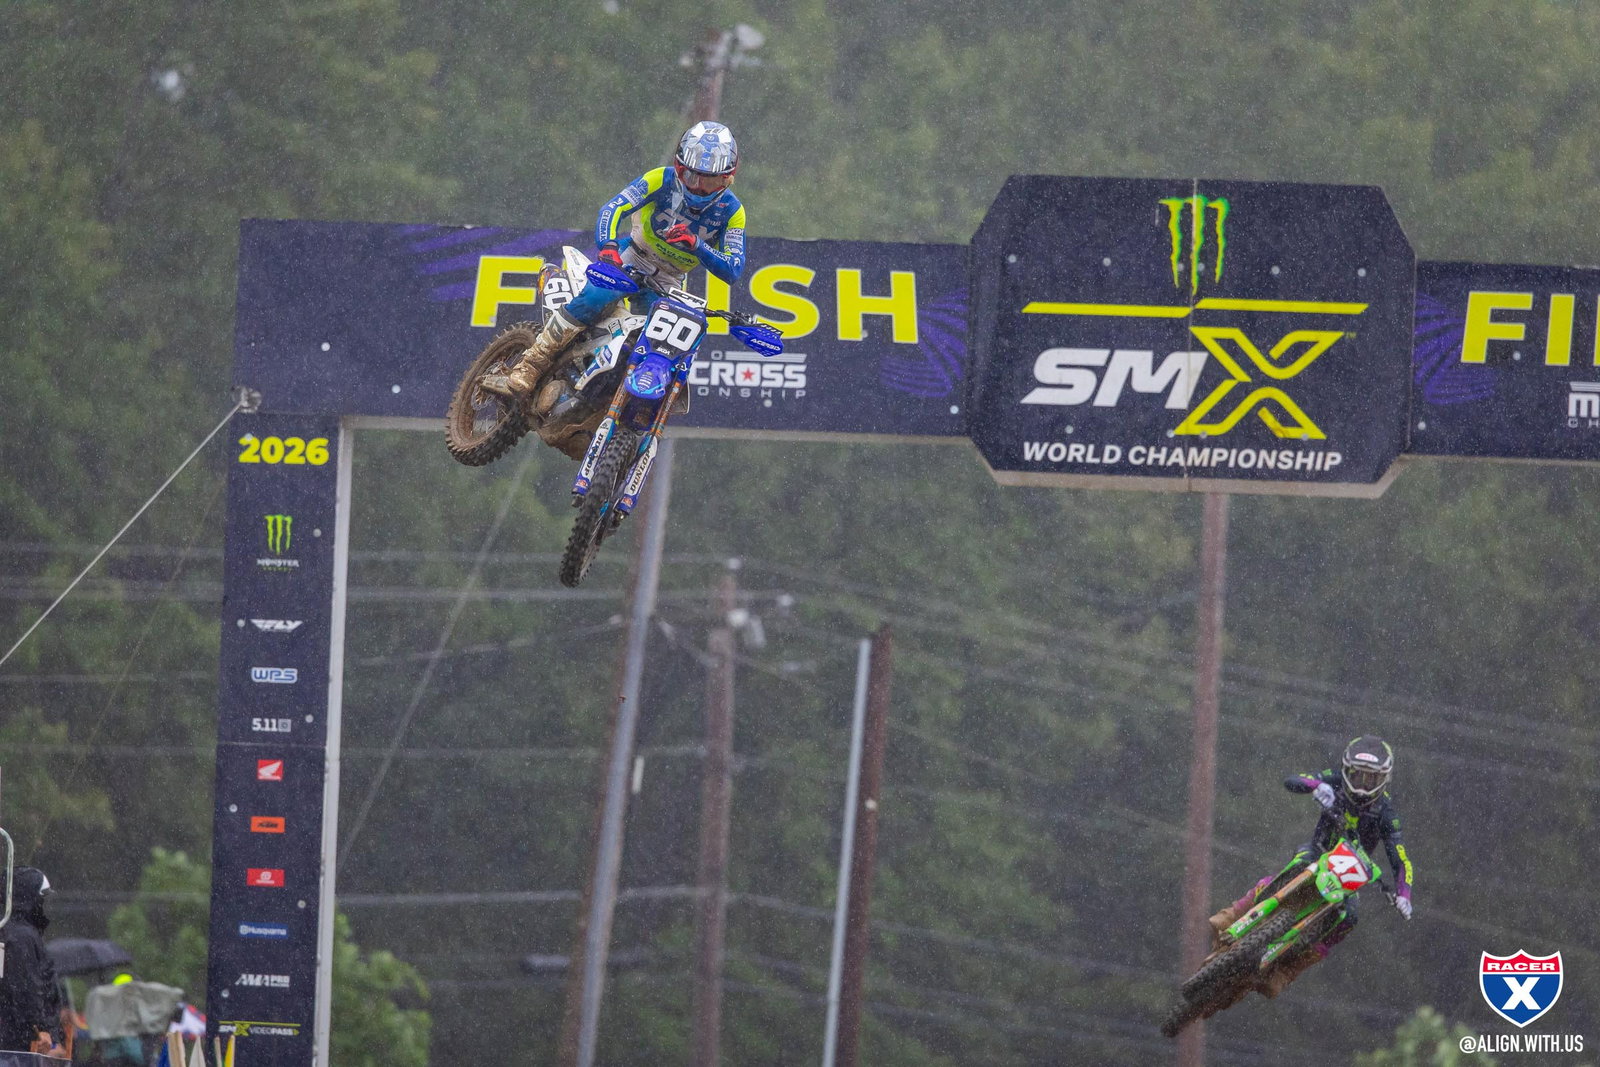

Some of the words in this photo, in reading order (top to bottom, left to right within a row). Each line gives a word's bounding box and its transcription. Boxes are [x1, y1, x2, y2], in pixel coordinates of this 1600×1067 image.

[470, 255, 919, 345] FISH
[543, 277, 574, 311] 60
[645, 309, 702, 352] 60
[1461, 291, 1600, 367] FI
[689, 360, 808, 388] CROSS
[1020, 326, 1345, 440] SMX
[697, 386, 807, 399] ONSHIP
[238, 436, 330, 466] 2026
[1023, 442, 1122, 466] WORLD
[1127, 446, 1342, 471] CHAMPIONSHIP
[630, 447, 652, 495] DUNLOP
[253, 669, 296, 682] WPS
[252, 717, 278, 732] 5.11
[1327, 855, 1369, 884] 47
